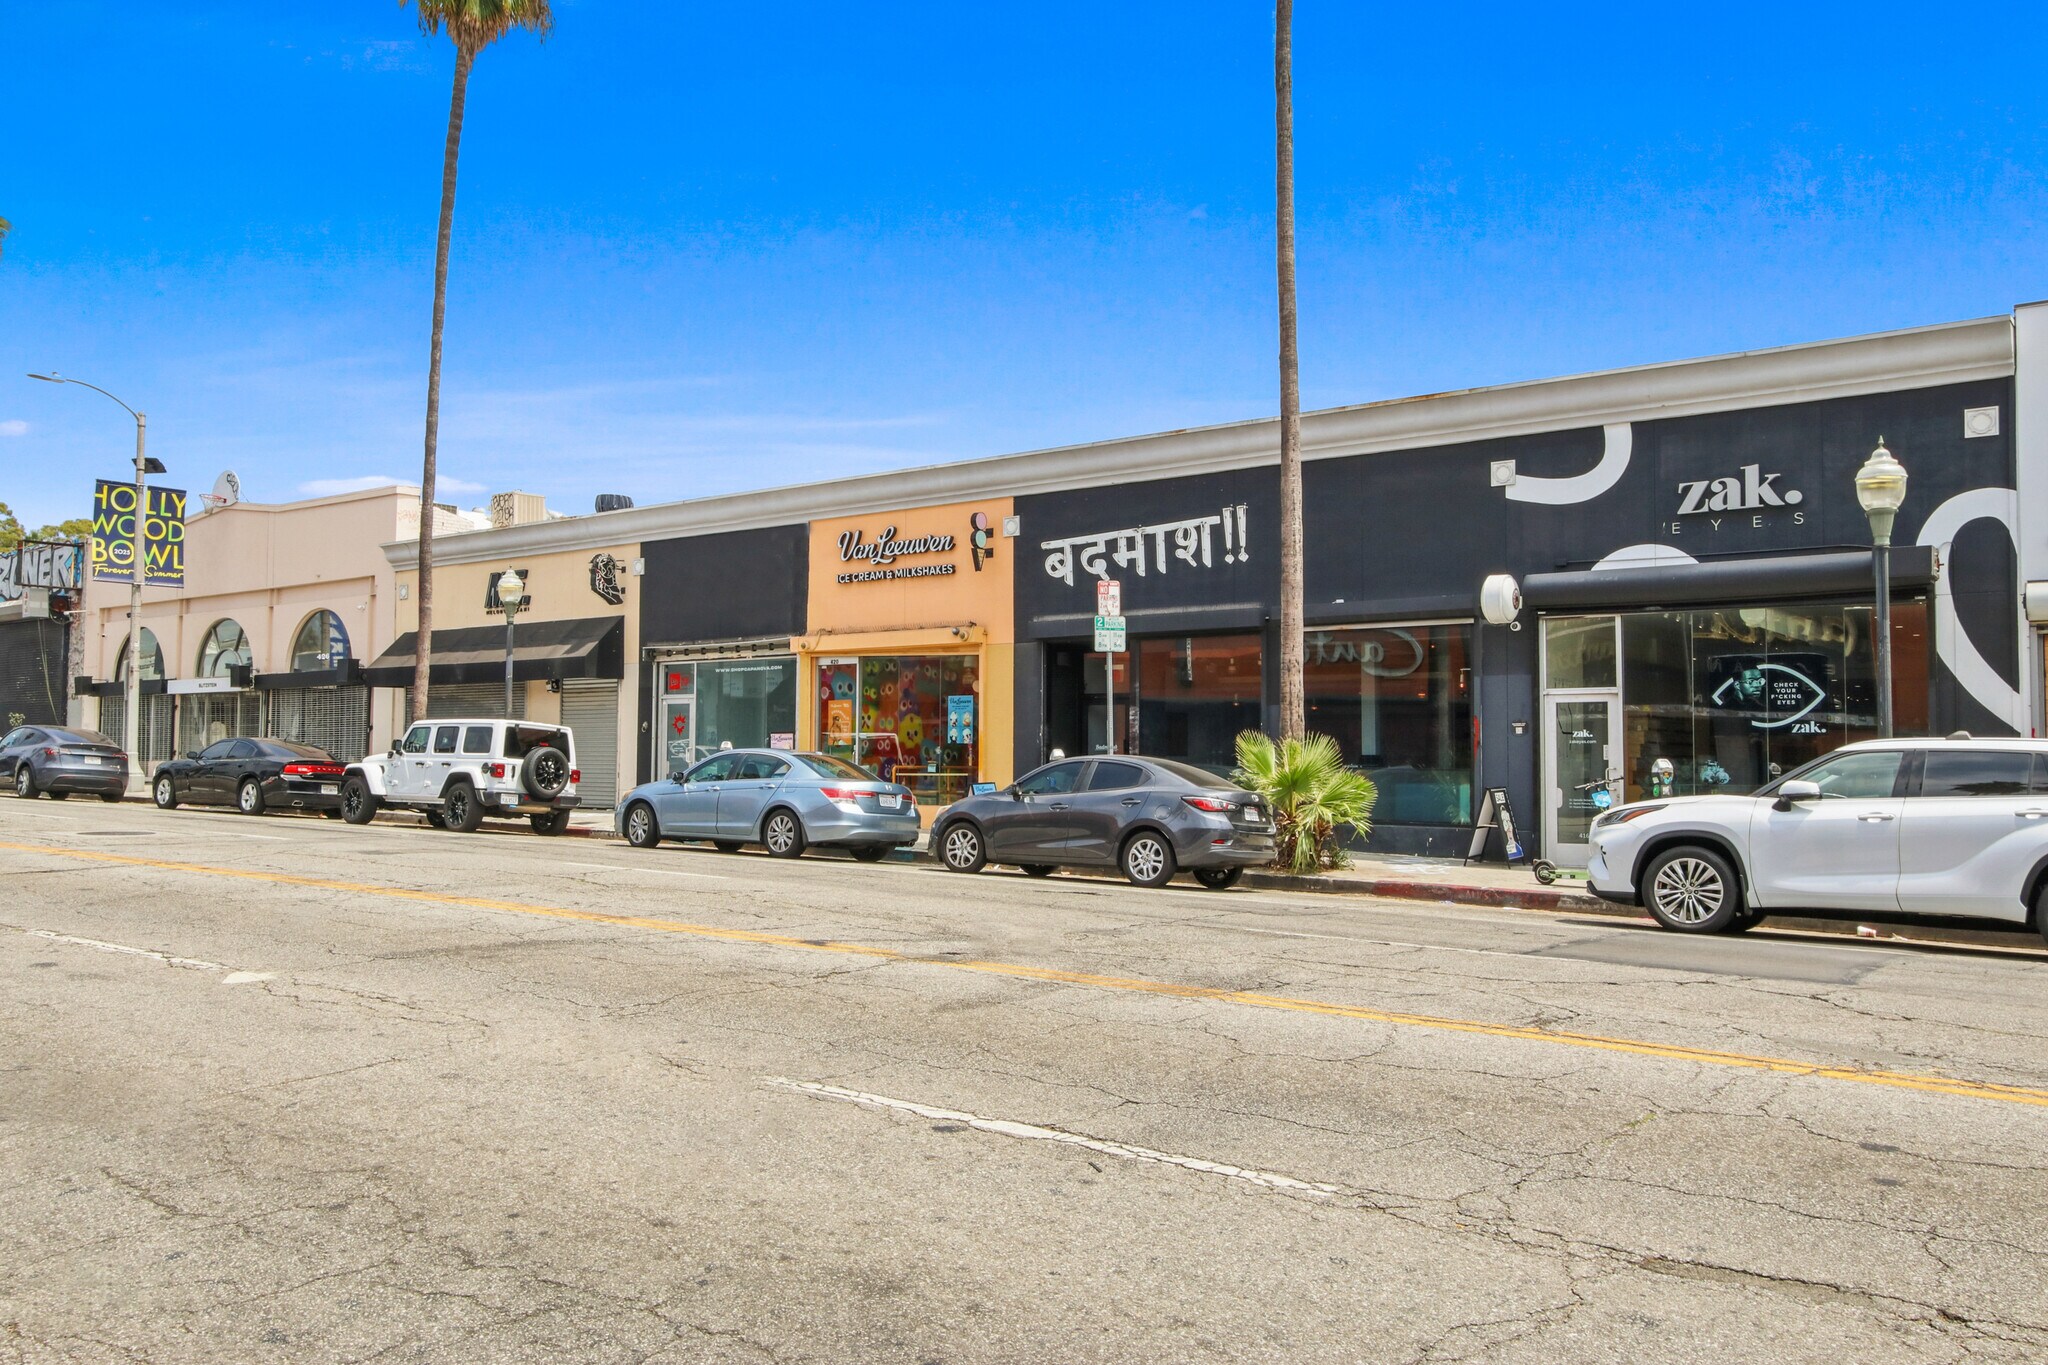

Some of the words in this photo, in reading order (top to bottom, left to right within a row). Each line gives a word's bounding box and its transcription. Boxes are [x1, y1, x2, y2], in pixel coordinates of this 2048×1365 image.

[1677, 464, 1803, 515] zak.
[1671, 512, 1804, 534] EYES
[92, 537, 184, 569] BOWL
[837, 530, 877, 561] Van
[870, 526, 954, 565] Leeuwen
[92, 564, 134, 576] Forever
[144, 565, 184, 578] Summer
[836, 574, 850, 583] ICE
[852, 570, 885, 582] CREAM
[886, 570, 893, 579] &
[895, 564, 954, 578] MILKSHAKES
[1097, 617, 1104, 627] 2
[1572, 729, 1594, 738] zak.
[1791, 721, 1827, 733] zak.
